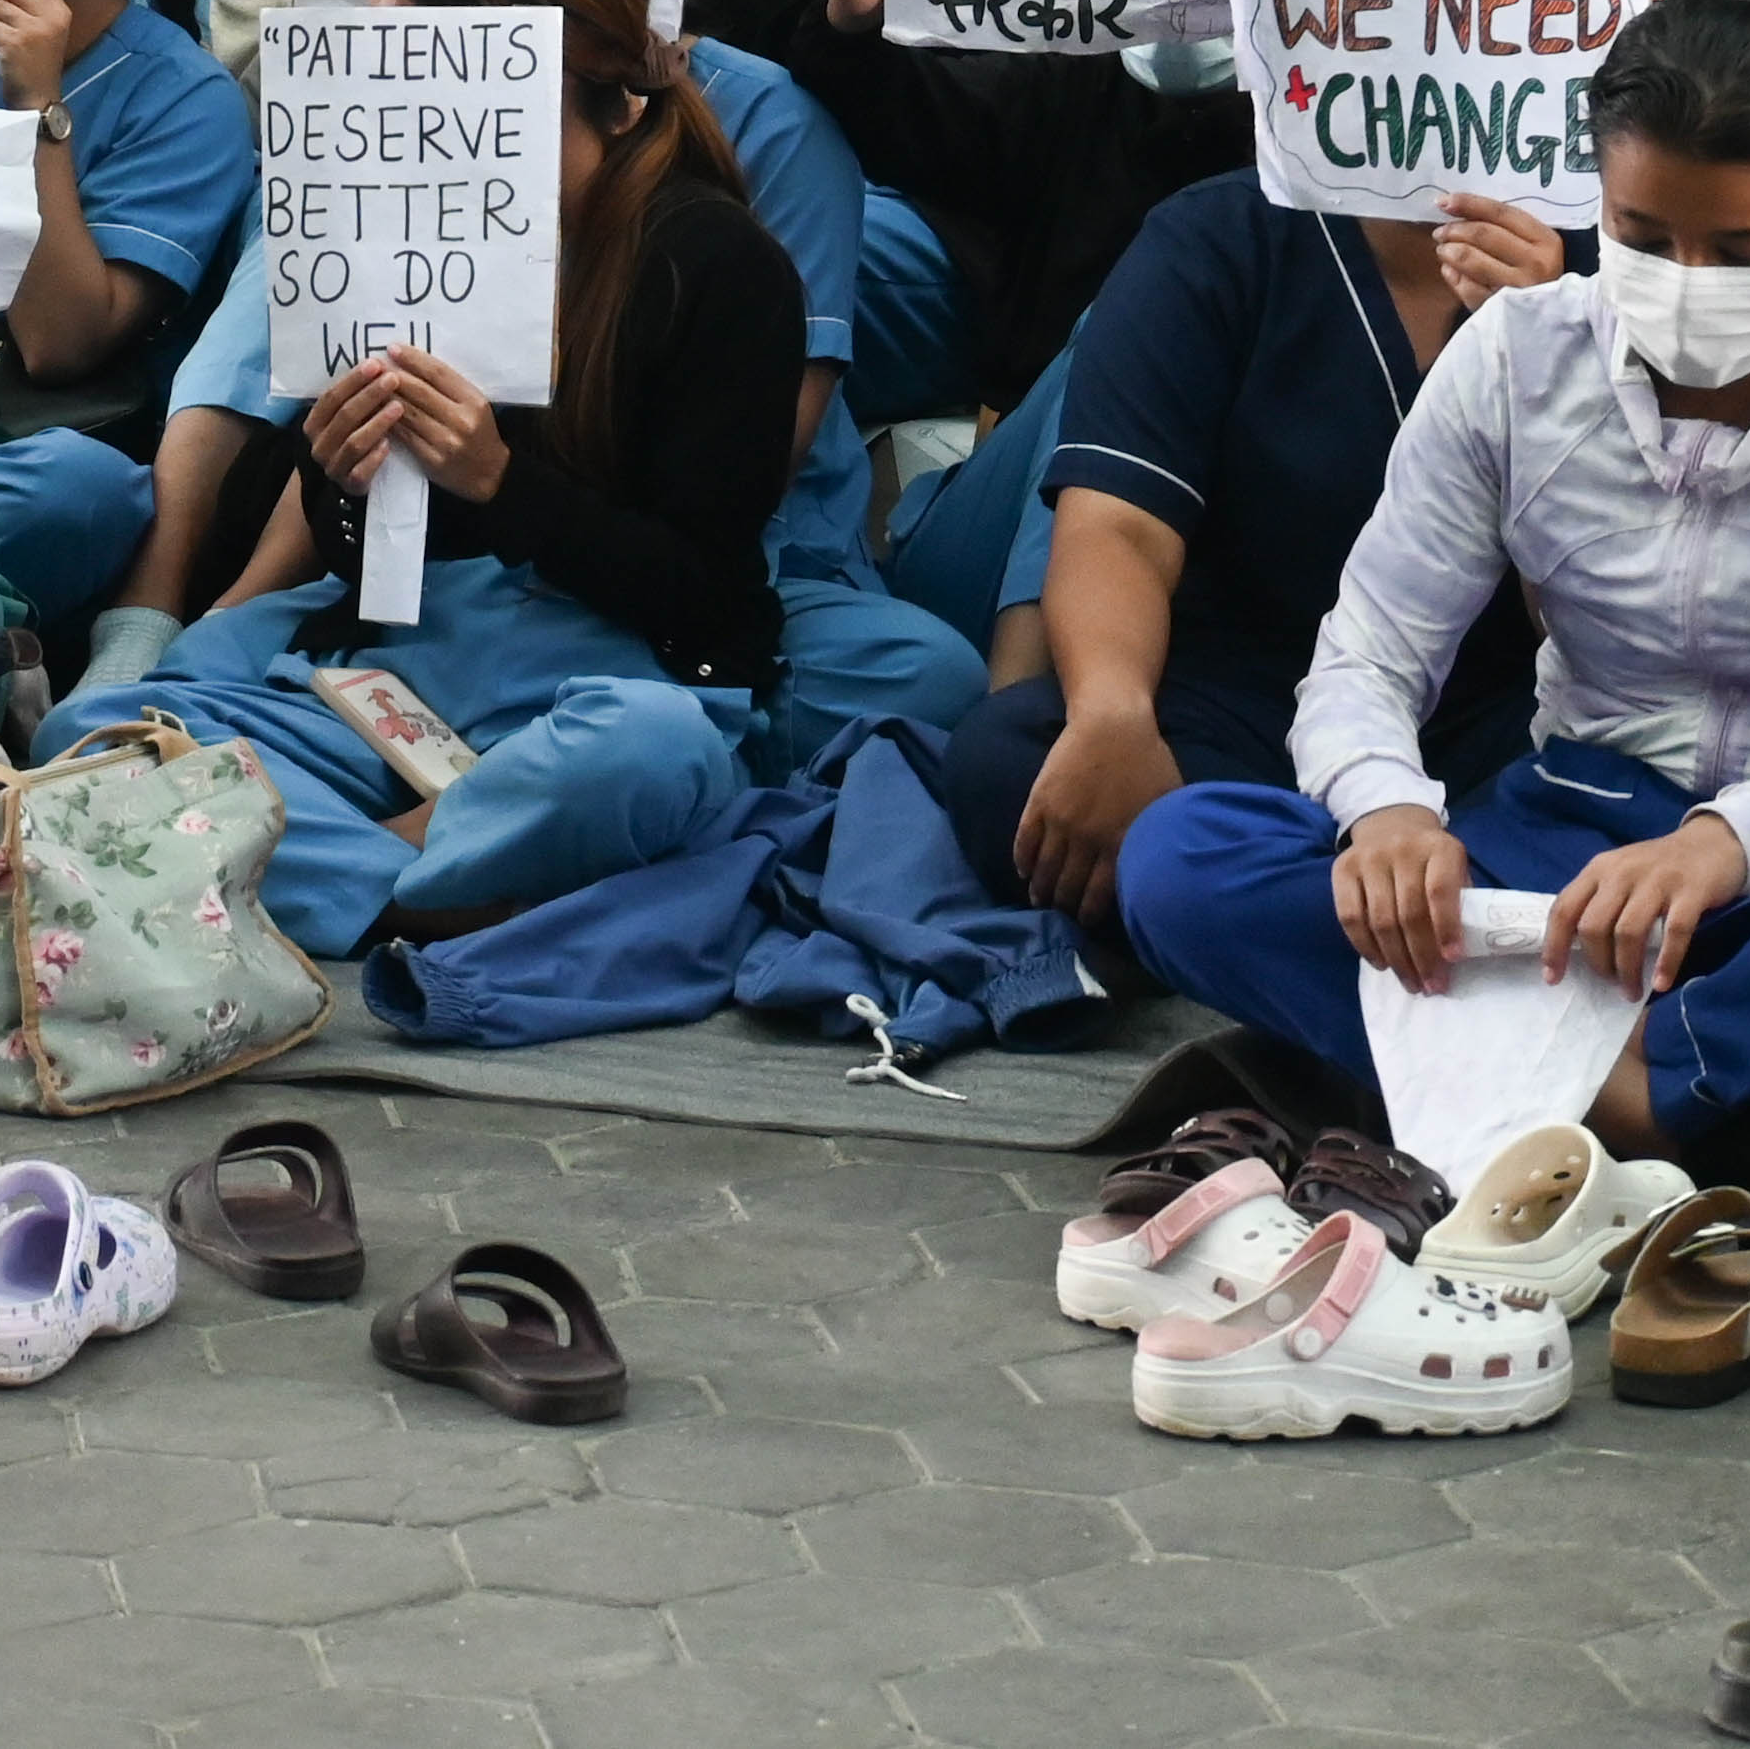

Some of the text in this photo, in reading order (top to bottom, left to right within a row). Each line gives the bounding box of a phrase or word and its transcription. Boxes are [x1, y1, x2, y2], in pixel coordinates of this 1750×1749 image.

[268, 101, 524, 163] DESERVE
[1315, 72, 1601, 188] CHANGE
[267, 176, 530, 242] BETTER
[273, 250, 475, 306] SO DO
